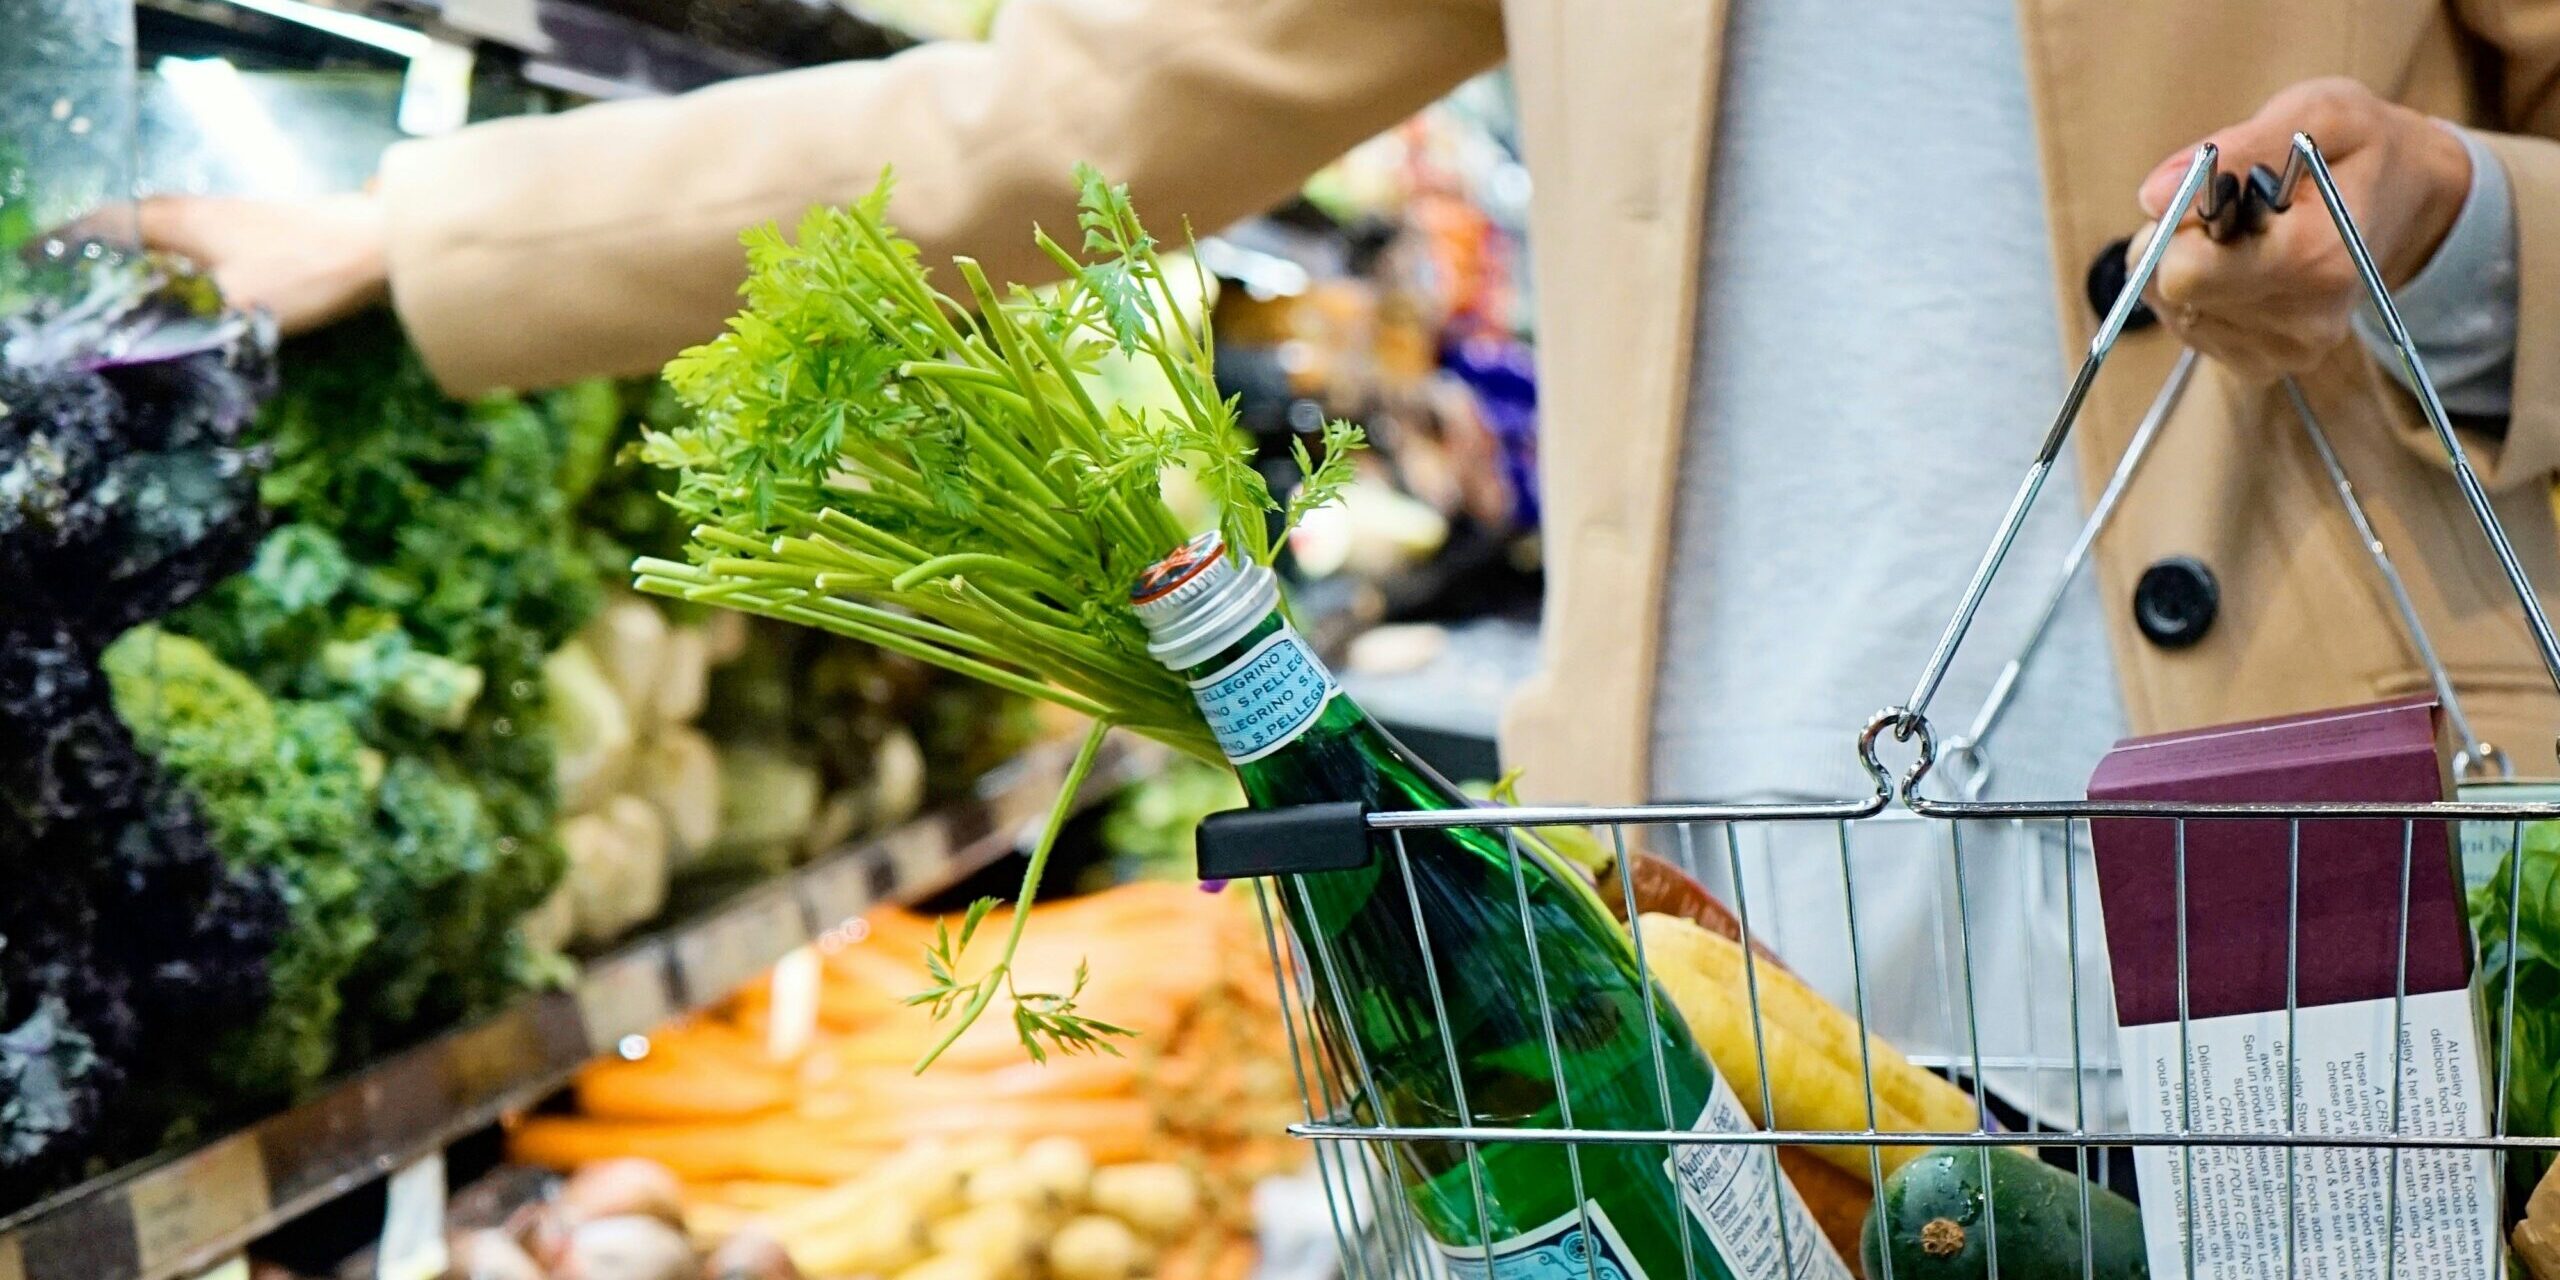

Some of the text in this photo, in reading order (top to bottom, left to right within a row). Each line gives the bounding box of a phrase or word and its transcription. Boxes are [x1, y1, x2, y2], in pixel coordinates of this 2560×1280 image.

[2242, 1034, 2257, 1062] Seul
[2431, 1027, 2447, 1083] delicious
[2447, 1039, 2458, 1053] At
[2156, 1057, 2168, 1087] vous
[2198, 1044, 2214, 1100] Délicieux
[2246, 1066, 2257, 1081] un
[2260, 1052, 2271, 1082] avec
[2340, 1060, 2353, 1079] but
[2354, 1051, 2368, 1086] these
[2405, 1066, 2417, 1075] &
[2445, 1057, 2463, 1098] Lesley
[2160, 1090, 2170, 1105] ne
[2327, 1060, 2341, 1106] cheese
[2374, 1085, 2384, 1095] A
[2407, 1080, 2420, 1100] her
[2205, 1104, 2216, 1120] au
[2248, 1084, 2263, 1128] produit
[2264, 1085, 2276, 1115] soin,
[2342, 1083, 2357, 1116] really
[2358, 1089, 2373, 1132] unique
[2424, 1097, 2435, 1116] are
[2438, 1086, 2451, 1117] food.
[2267, 1118, 2278, 1133] en
[2297, 1102, 2309, 1134] Stow
[2318, 1107, 2329, 1136] snac
[2332, 1110, 2342, 1123] or
[2376, 1099, 2390, 1140] CRIS
[2411, 1104, 2422, 1135] team
[2272, 1040, 2284, 1056] de
[2295, 1202, 2310, 1253] fabuleux
[2399, 1126, 2412, 1153] frm
[2443, 1120, 2456, 1159] The
[2198, 1157, 2210, 1172] de
[2273, 1146, 2284, 1178] etites
[2334, 1125, 2351, 1185] apasto.
[2367, 1146, 2380, 1188] ackers
[1689, 1155, 1725, 1195] Valeur
[2168, 1159, 2183, 1185] plus
[2214, 1173, 2226, 1195] ces
[2229, 1166, 2243, 1207] POUR
[2327, 1177, 2337, 1186] &
[2354, 1156, 2366, 1190] when
[2403, 1157, 2418, 1202] scratch
[2419, 1173, 2432, 1193] the
[2432, 1159, 2445, 1184] with
[2243, 1146, 2257, 1191] pouvait
[2251, 1194, 2265, 1249] satisfaire
[2306, 1175, 2320, 1213] Foods
[2327, 1190, 2340, 1211] are
[2343, 1187, 2356, 1208] We
[2373, 1190, 2383, 1211] are
[2436, 1187, 2447, 1215] care
[2448, 1162, 2463, 1214] fabulous
[2465, 1175, 2478, 1214] Foods
[2200, 1177, 2216, 1239] trempette,
[2262, 1179, 2277, 1228] fabriqué
[2357, 1193, 2372, 1236] topped
[2421, 1196, 2436, 1222] only
[2217, 1198, 2236, 1261] craquelins
[2234, 1210, 2248, 1240] CES
[2312, 1216, 2324, 1252] adore
[2331, 1214, 2343, 1240] sure
[2347, 1212, 2356, 1232] are
[2408, 1205, 2421, 1238] using
[2440, 1219, 2450, 1230] in
[2453, 1217, 2468, 1255] crisps
[2469, 1217, 2480, 1235] we
[2210, 1242, 2221, 1257] de
[2270, 1232, 2280, 1262] avec
[2364, 1238, 2377, 1264] with
[2414, 1241, 2424, 1261] our
[2424, 1225, 2437, 1249] way
[2443, 1233, 2454, 1266] small
[2472, 1239, 2485, 1264] love
[2239, 1242, 2253, 1275] FINS
[2334, 1245, 2347, 1267] you
[2430, 1253, 2440, 1265] to
